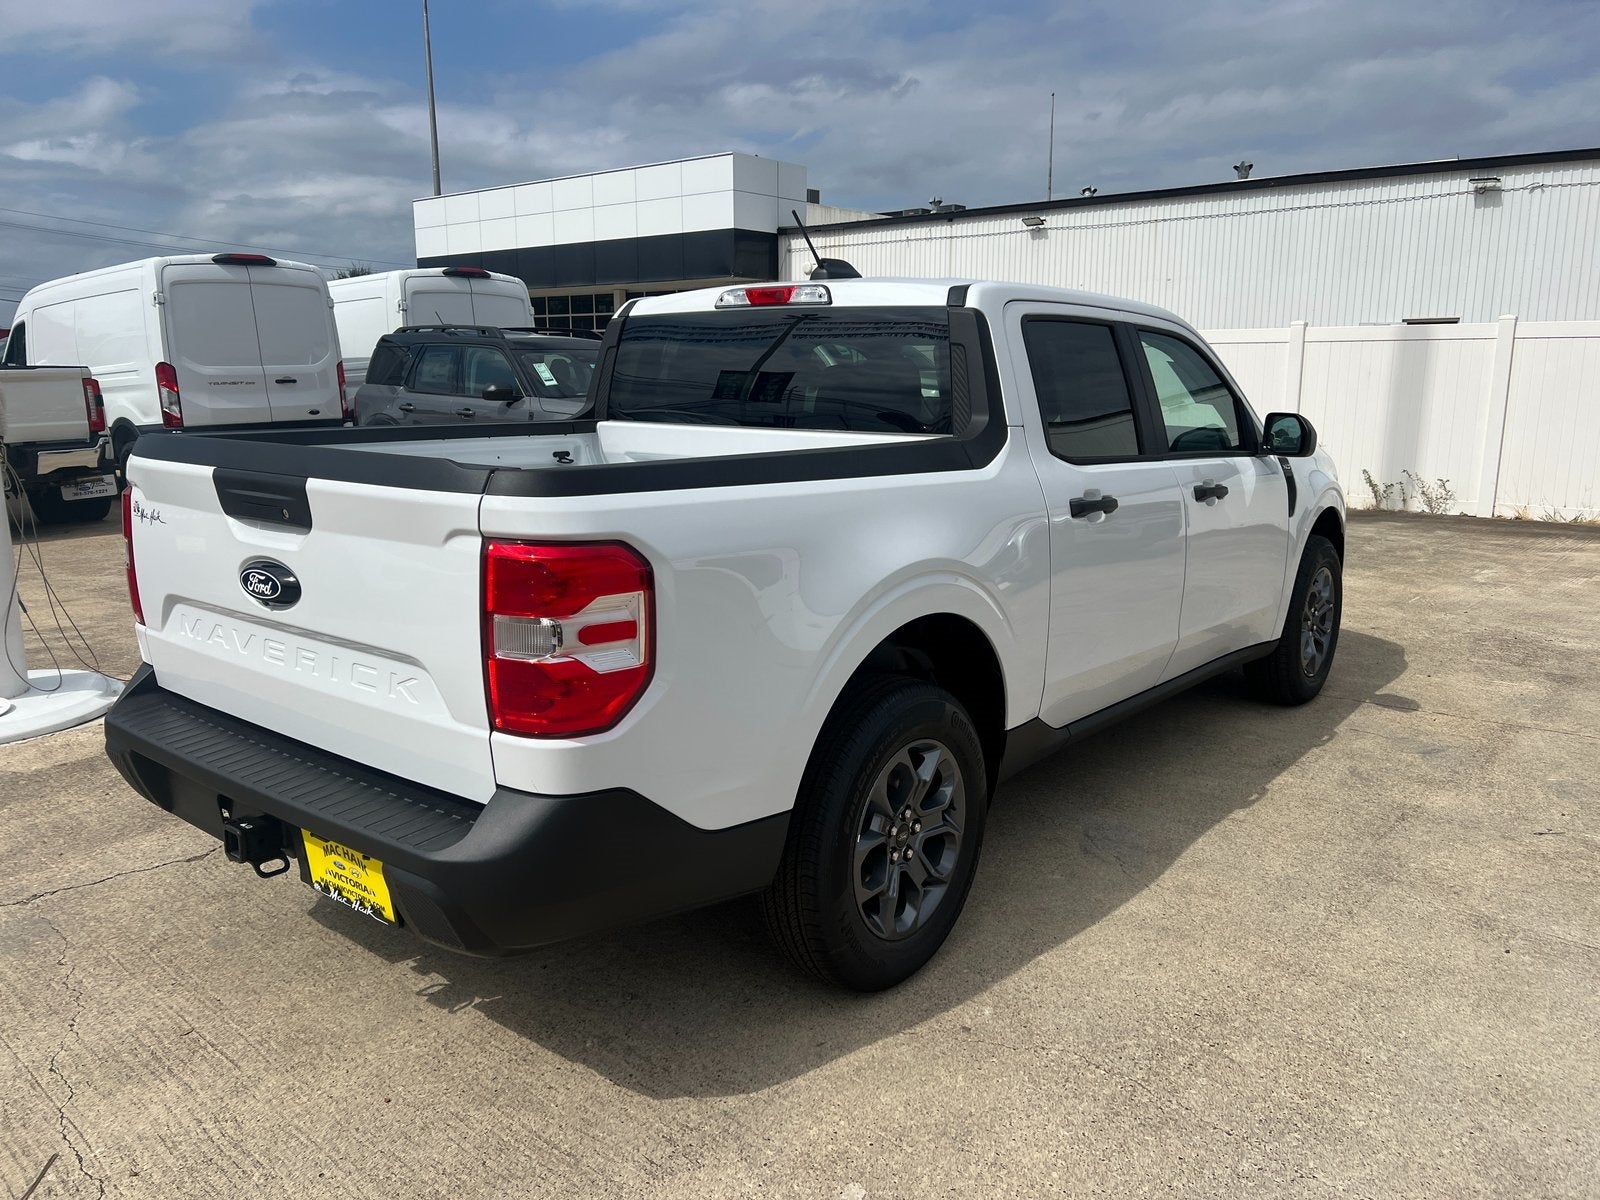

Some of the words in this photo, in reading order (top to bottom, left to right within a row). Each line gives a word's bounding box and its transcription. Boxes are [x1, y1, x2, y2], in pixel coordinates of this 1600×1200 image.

[247, 572, 273, 595] Ford
[179, 613, 420, 705] MAVERICK
[322, 844, 342, 858] MAC
[332, 871, 370, 895] VICTORIA
[328, 888, 352, 907] Mac
